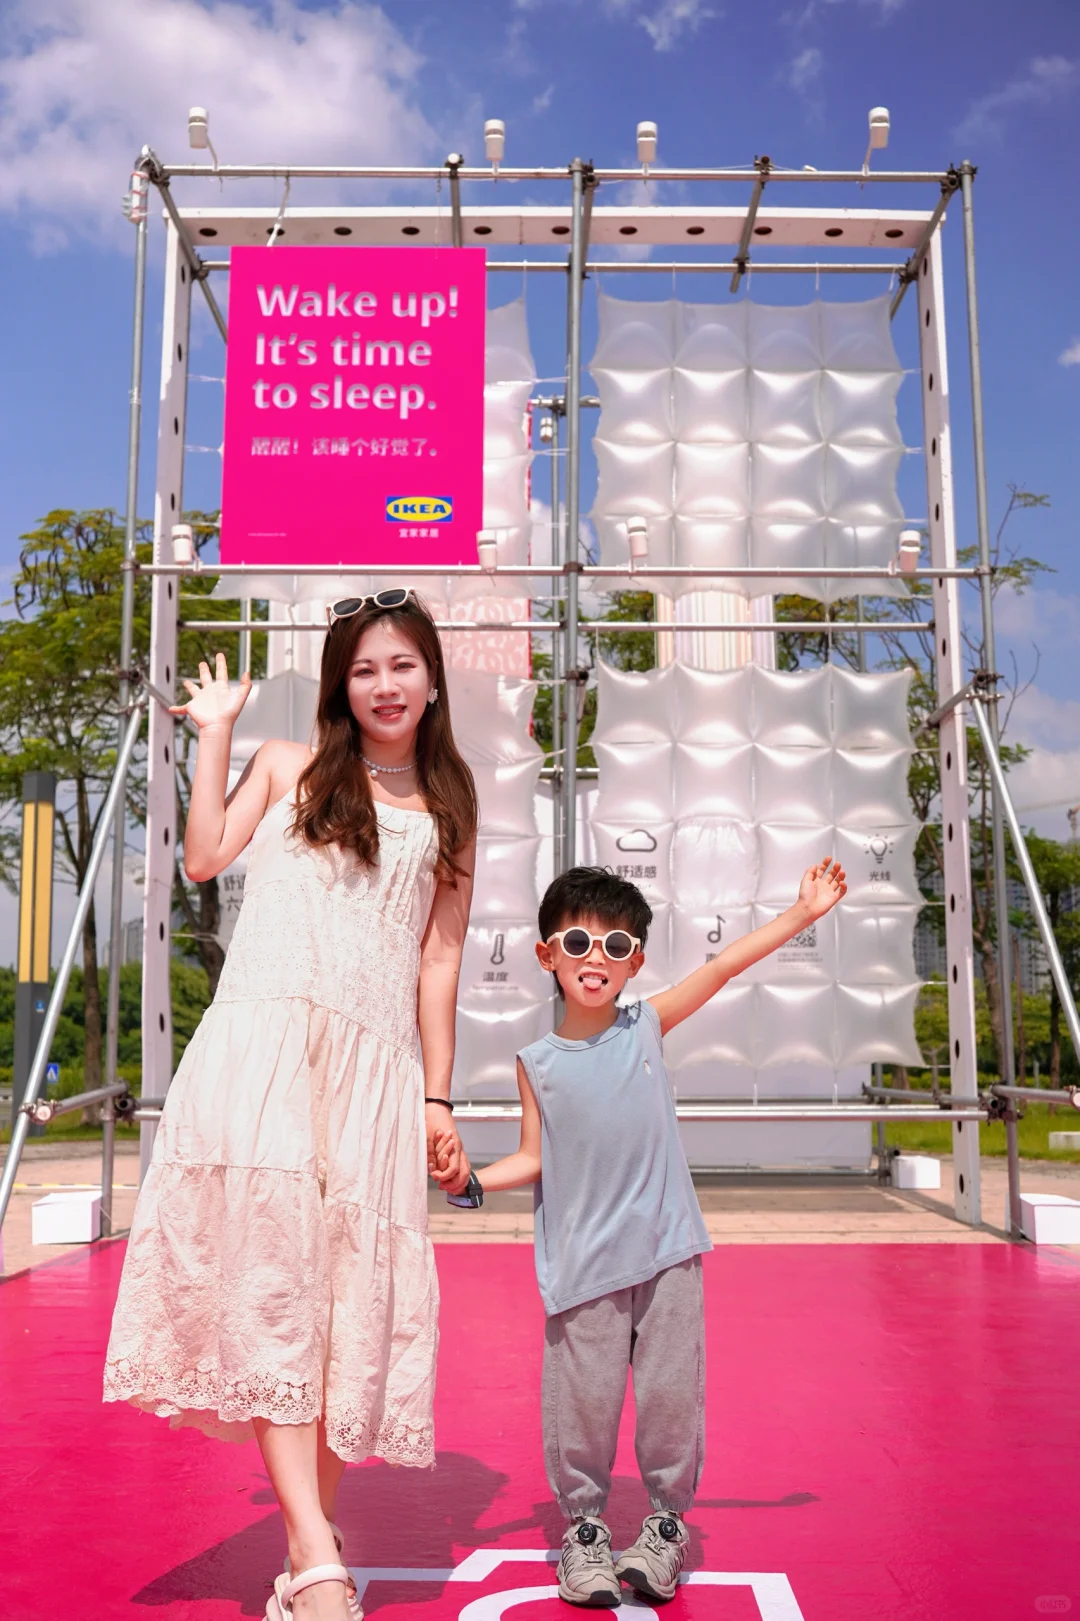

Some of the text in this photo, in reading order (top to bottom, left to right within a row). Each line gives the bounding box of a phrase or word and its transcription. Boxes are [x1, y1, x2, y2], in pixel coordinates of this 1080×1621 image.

[256, 283, 459, 328] Wake up!
[255, 331, 433, 367] It’s time
[251, 375, 437, 420] to sleep.
[393, 503, 447, 514] IKEA
[869, 870, 891, 882] 光线
[482, 971, 509, 982] 温度
